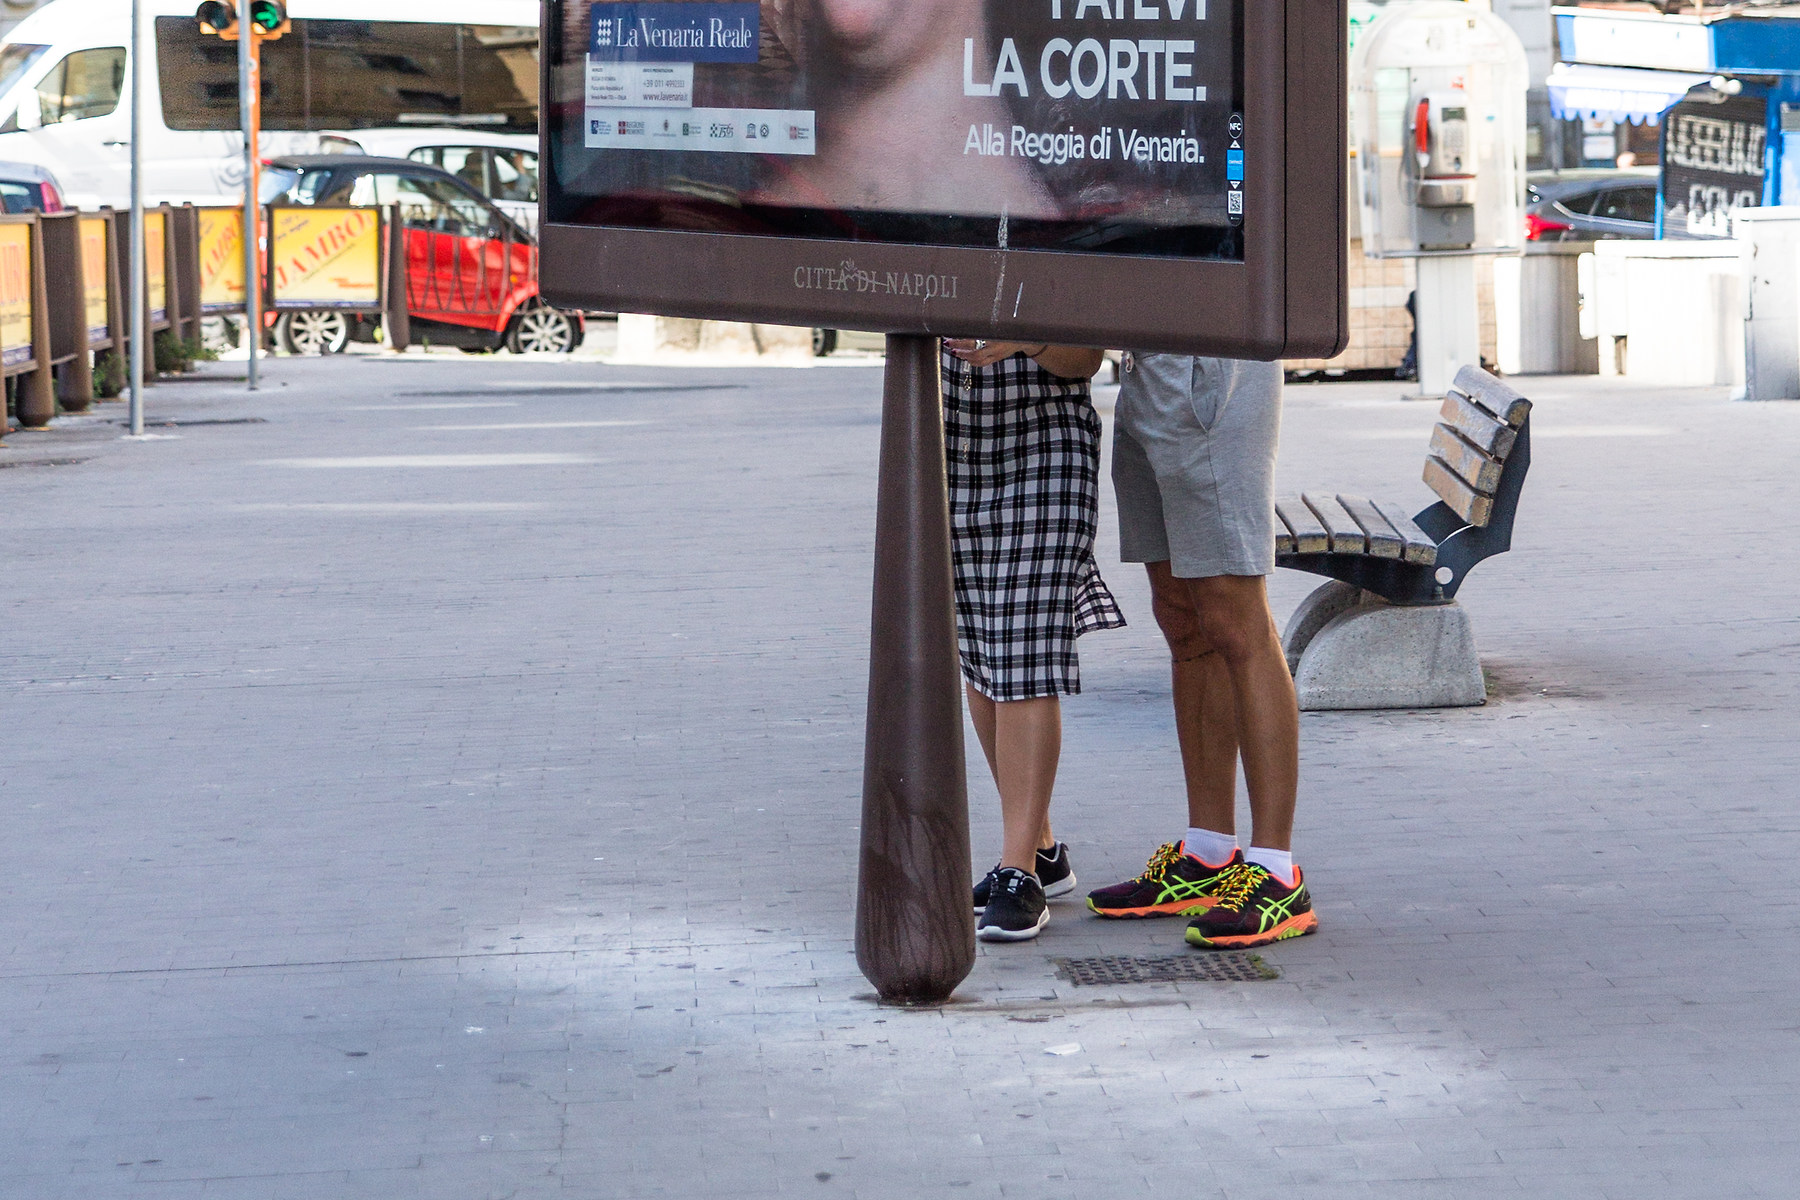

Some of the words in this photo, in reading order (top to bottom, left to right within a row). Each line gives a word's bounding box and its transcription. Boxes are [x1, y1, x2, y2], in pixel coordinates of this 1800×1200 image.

[616, 18, 639, 48] La
[640, 17, 704, 48] Venaria
[708, 17, 752, 48] Reale
[963, 37, 1029, 97] LA
[1040, 37, 1207, 101] CORTE.
[1229, 122, 1242, 131] NFC
[963, 123, 1005, 156] Alla
[1010, 125, 1085, 165] Reggia
[1090, 126, 1112, 160] di
[1118, 128, 1205, 163] Venaria.
[857, 269, 878, 294] DI
[885, 271, 959, 299] NAPOLI
